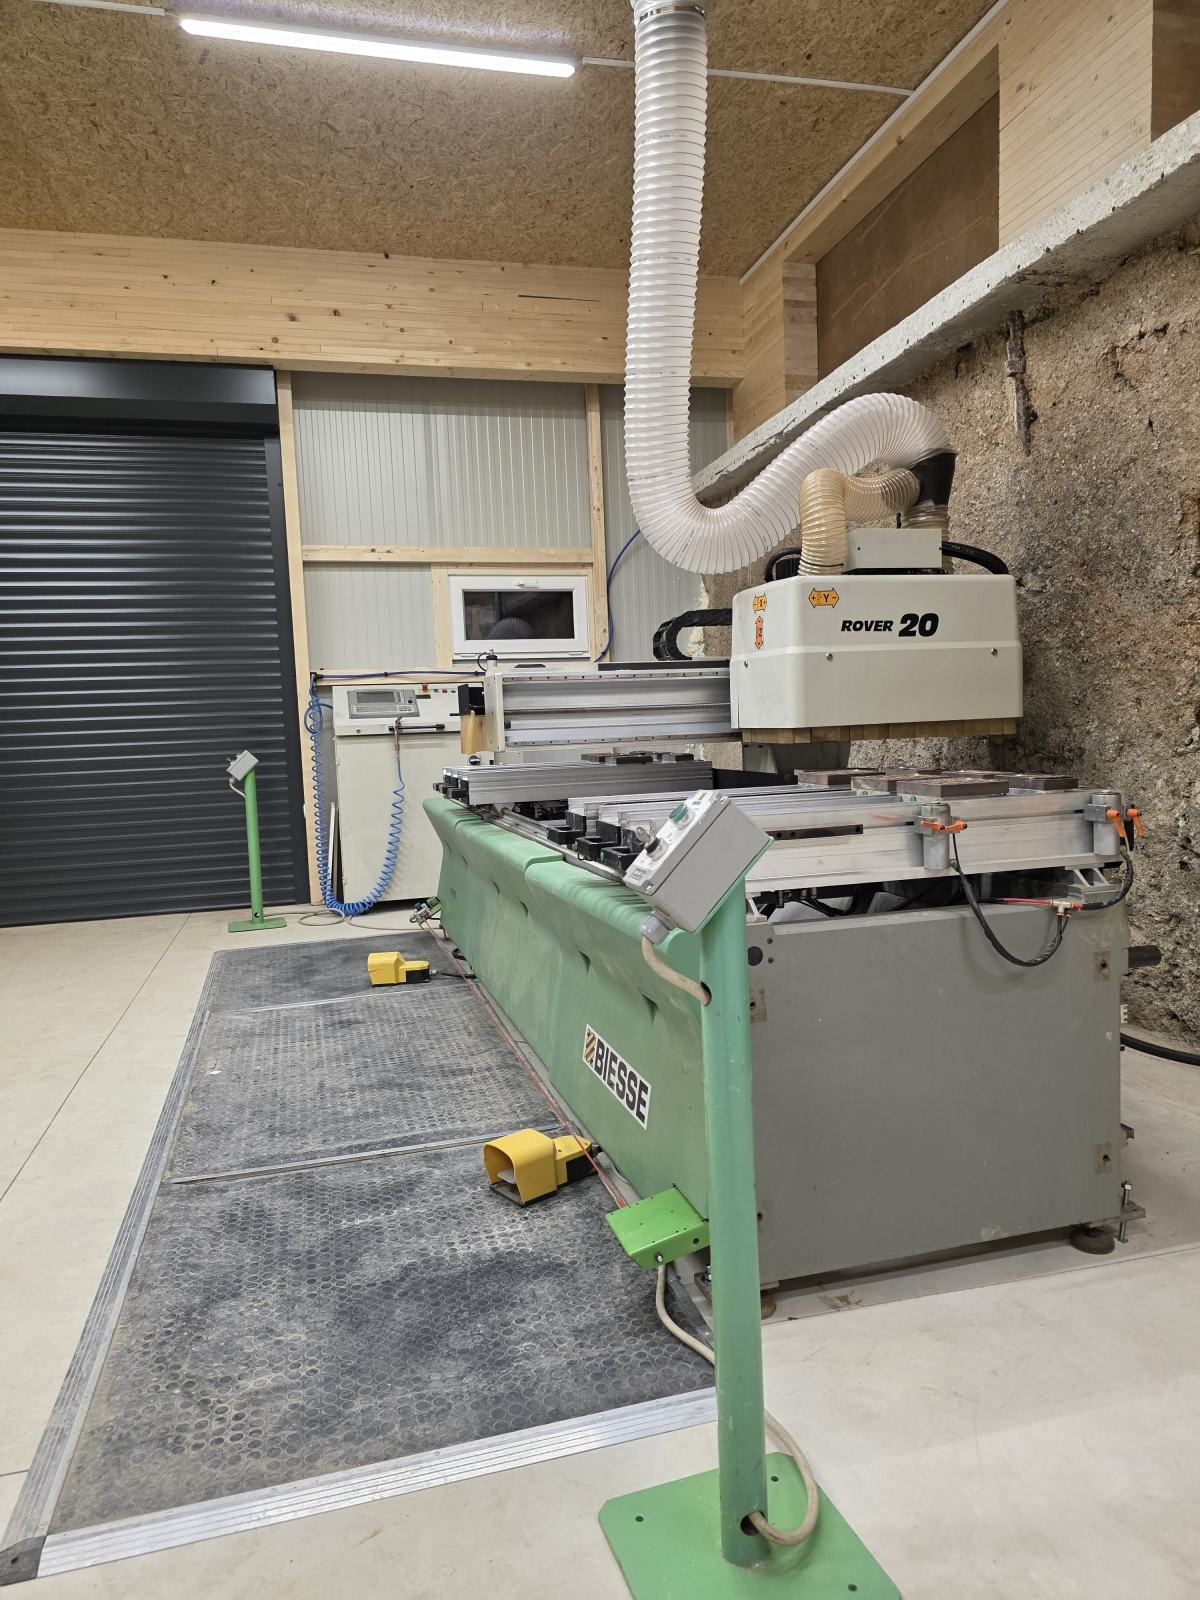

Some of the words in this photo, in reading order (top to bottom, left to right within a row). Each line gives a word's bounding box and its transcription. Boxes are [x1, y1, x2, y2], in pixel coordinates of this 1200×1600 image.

[841, 620, 894, 632] ROVER
[898, 612, 939, 637] 20
[594, 1038, 649, 1124] BIESSE
